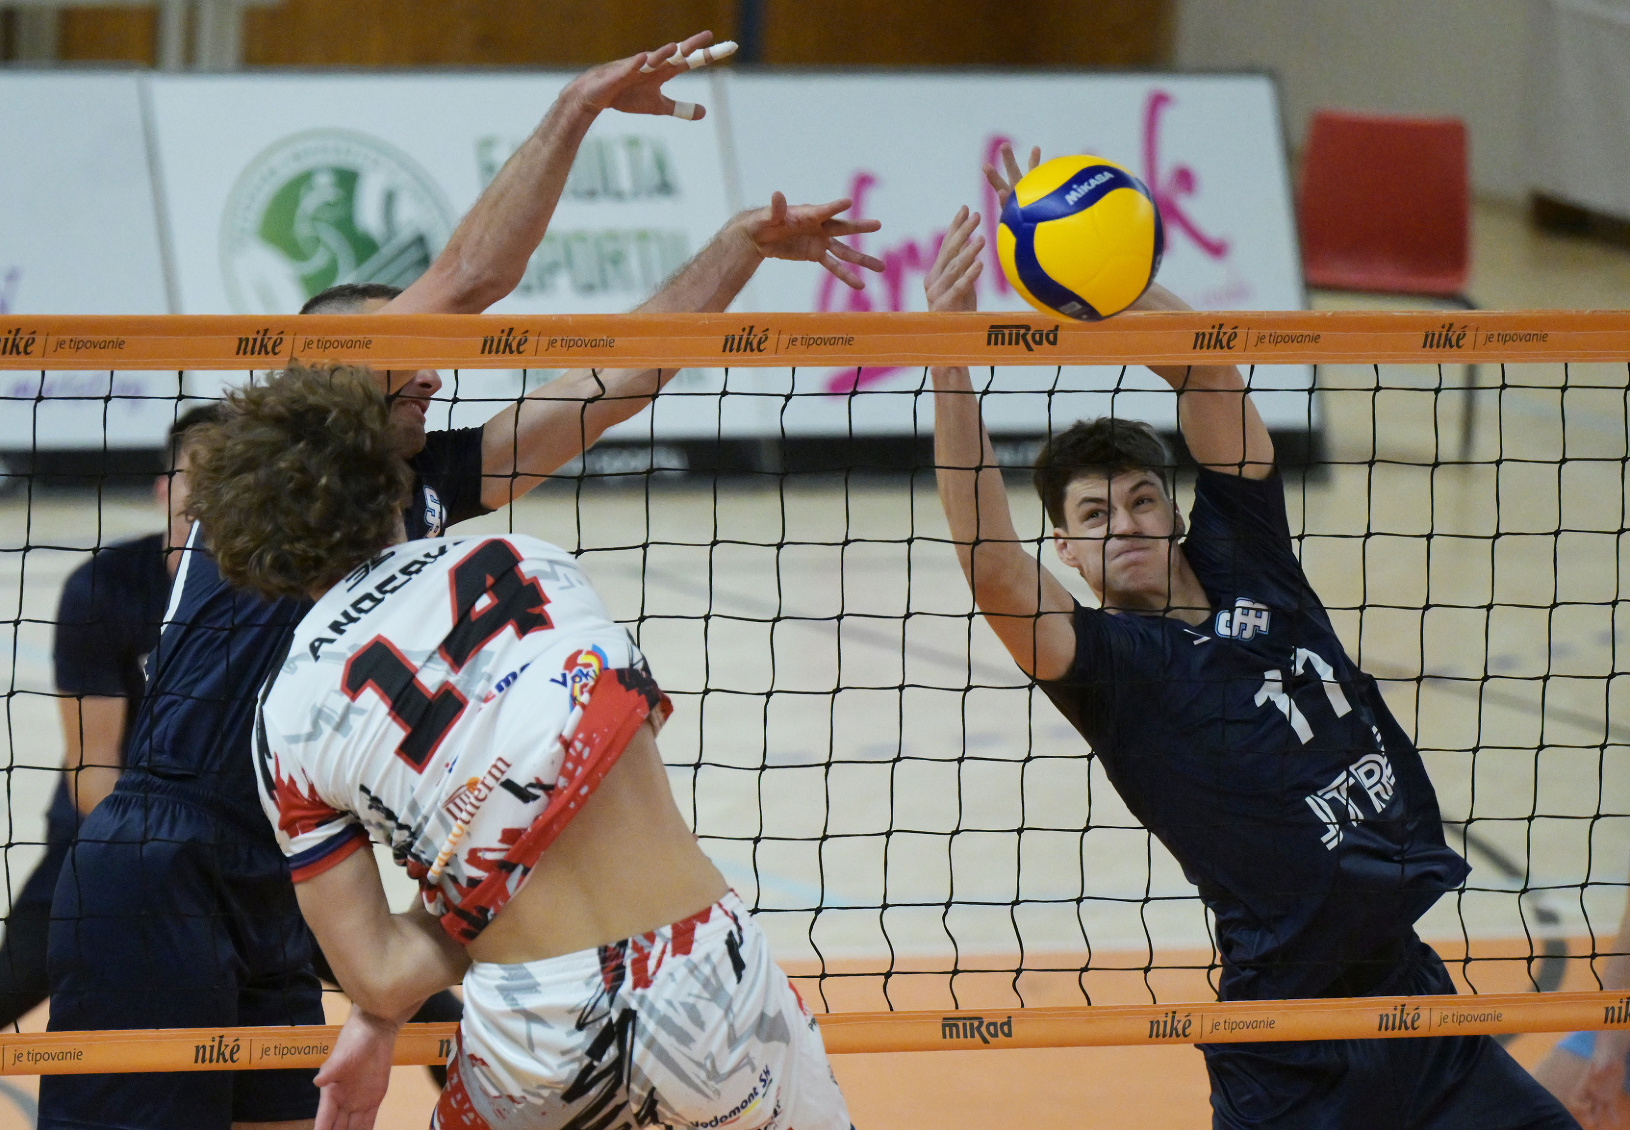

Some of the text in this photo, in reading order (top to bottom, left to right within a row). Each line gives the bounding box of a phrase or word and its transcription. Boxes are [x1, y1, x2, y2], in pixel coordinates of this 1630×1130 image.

[54, 338, 66, 353] je
[68, 337, 126, 353] tipovanie
[236, 328, 373, 356] niké je tipovanie
[480, 327, 616, 355] niké je tipovanie
[721, 325, 855, 353] niké je tipovanie
[1192, 323, 1321, 350] niké je tipovanie
[1422, 323, 1549, 349] niké je tipovanie
[340, 537, 554, 775] 14
[1148, 1011, 1276, 1039] niké je tipovanie
[1377, 1004, 1503, 1032] niké je tipovanie
[1604, 997, 1630, 1025] nik
[12, 1047, 84, 1065] je tipovanie
[193, 1035, 329, 1064] niké je tipovanie
